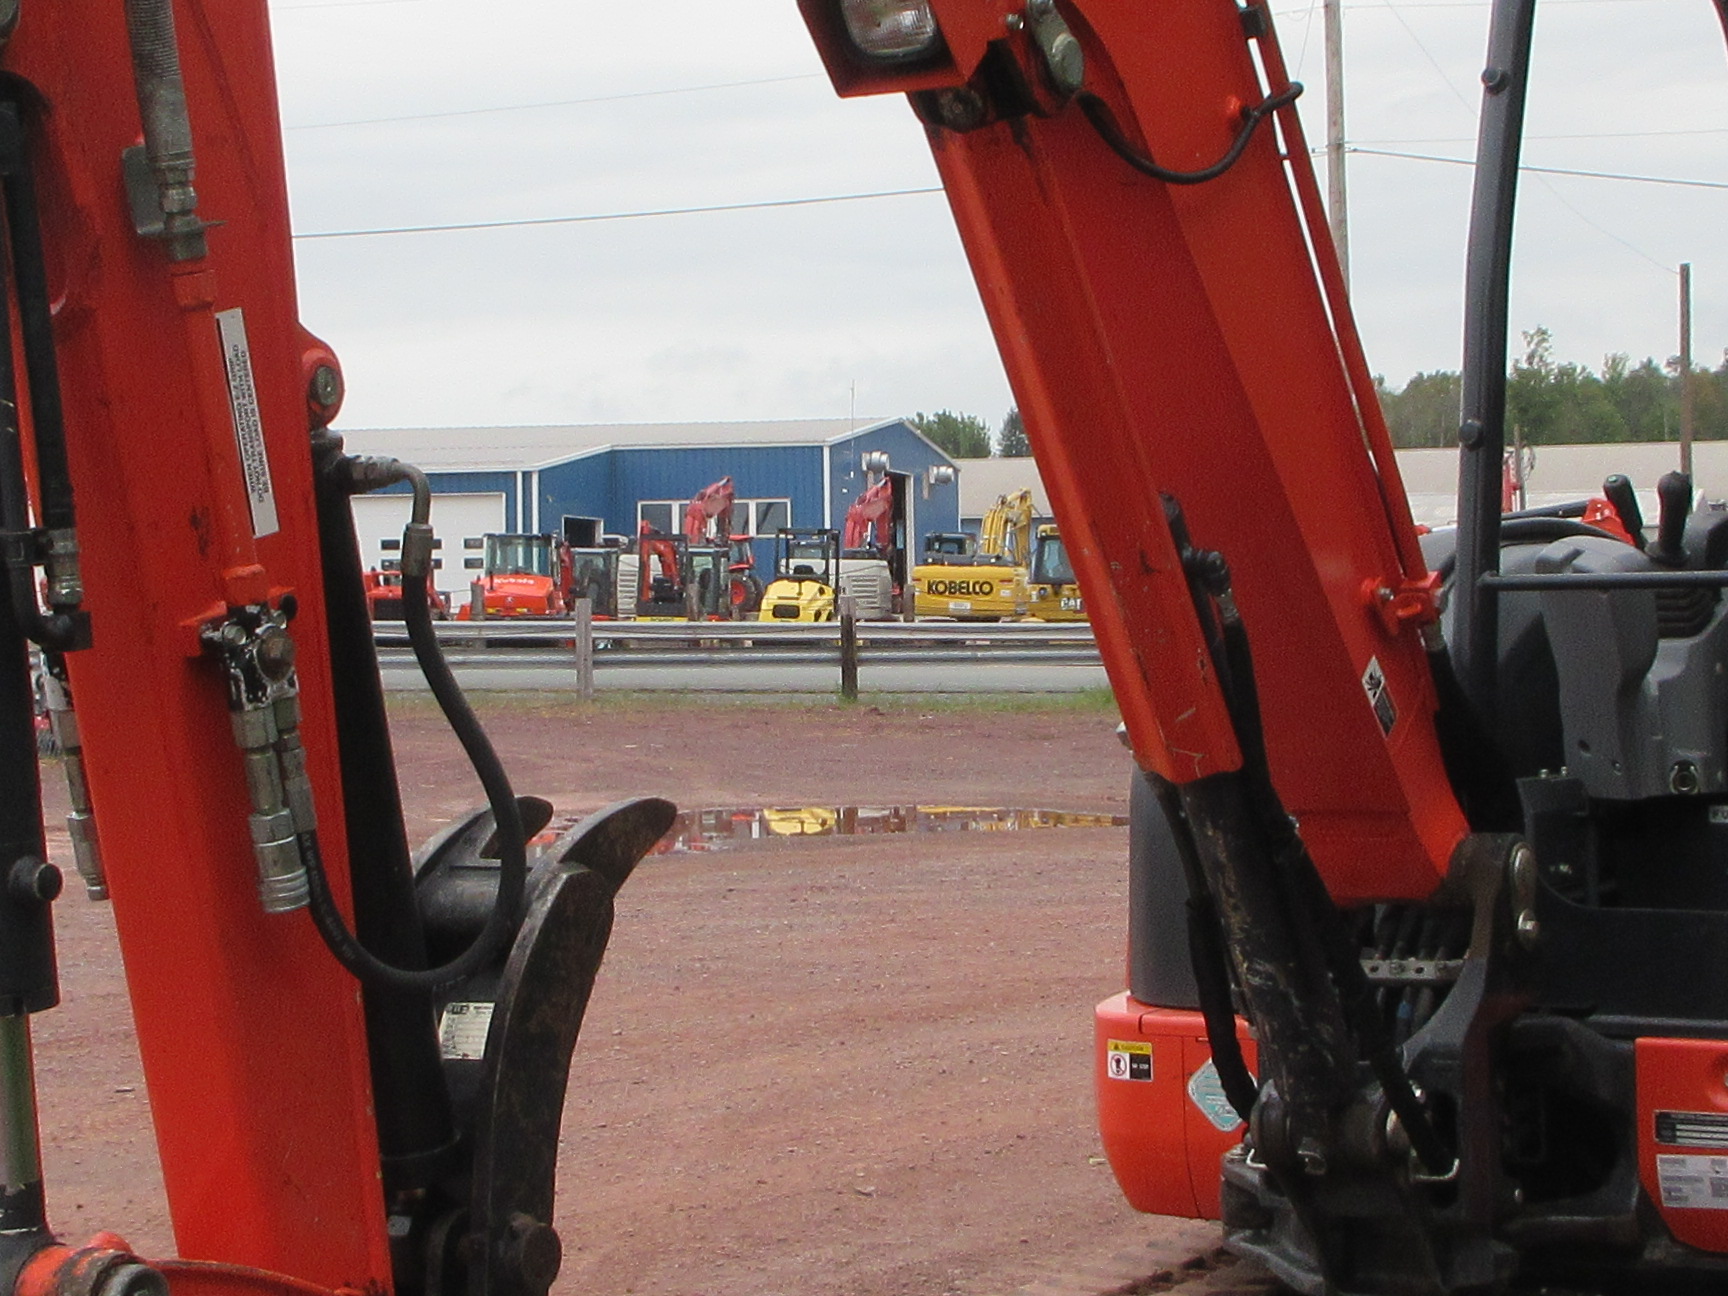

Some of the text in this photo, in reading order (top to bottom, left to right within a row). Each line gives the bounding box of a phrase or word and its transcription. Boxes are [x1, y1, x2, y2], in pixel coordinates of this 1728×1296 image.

[239, 349, 254, 405] CENTERED
[231, 343, 265, 503] DO NOT TRANSPORT WITH LOAD
[235, 402, 251, 461] OPERATING
[251, 418, 261, 447] LOAD
[256, 448, 266, 476] SURE
[246, 463, 256, 493] WHEN
[261, 479, 269, 493] BE
[927, 580, 993, 596] KOBELCO
[1060, 597, 1083, 611] CAT
